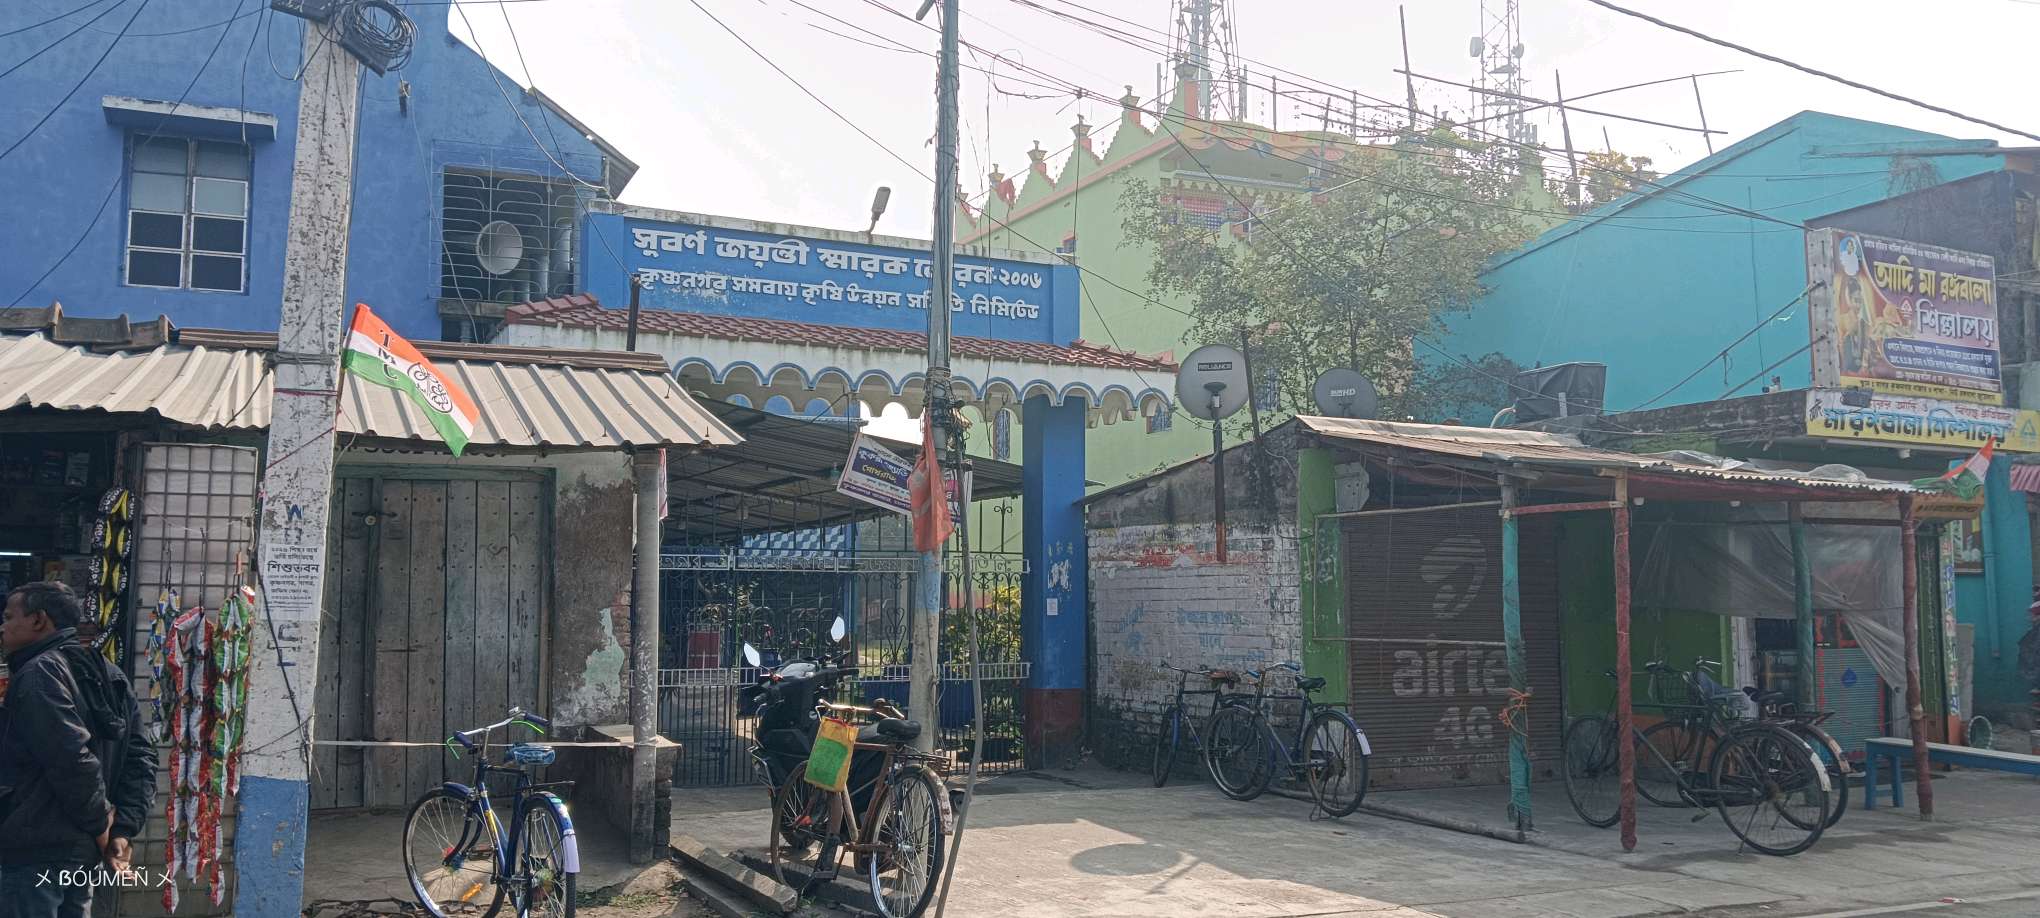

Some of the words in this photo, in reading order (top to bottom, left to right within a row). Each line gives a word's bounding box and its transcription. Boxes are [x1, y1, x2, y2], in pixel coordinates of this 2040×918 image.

[632, 227, 707, 258] সুবর্ণ
[714, 238, 810, 269] জয়ন্তী
[817, 248, 910, 279] স্মারক
[1873, 255, 1914, 293] আদি
[1918, 268, 1936, 297] মা
[638, 268, 729, 290] কৃষ্ণনগর
[732, 275, 798, 301] সমবায়
[801, 279, 844, 306] কৃষি
[847, 283, 901, 308] উন্নয়ন
[970, 293, 1040, 320] লিমিটেড
[266, 560, 320, 573] শিশুভবন
